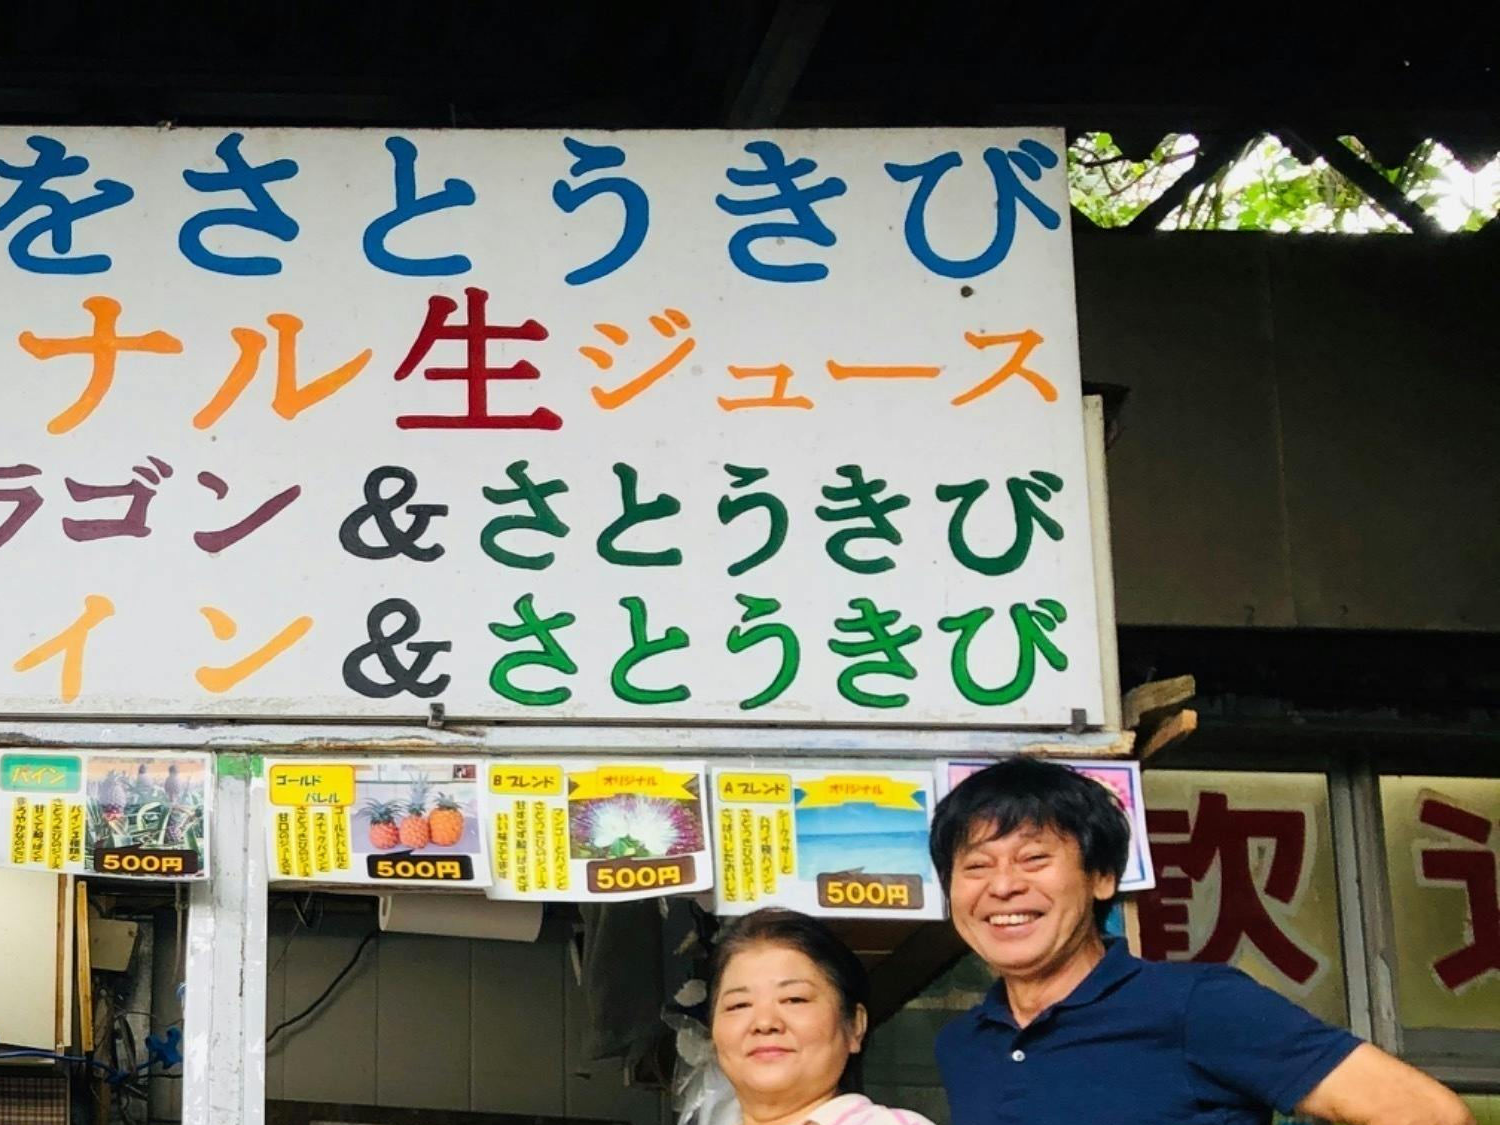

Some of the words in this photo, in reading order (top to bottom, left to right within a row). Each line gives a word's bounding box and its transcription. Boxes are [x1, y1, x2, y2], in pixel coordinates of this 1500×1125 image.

[103, 854, 183, 872] 500円
[377, 861, 461, 879] 500円
[597, 865, 681, 889] 500円
[826, 881, 909, 905] 500円
